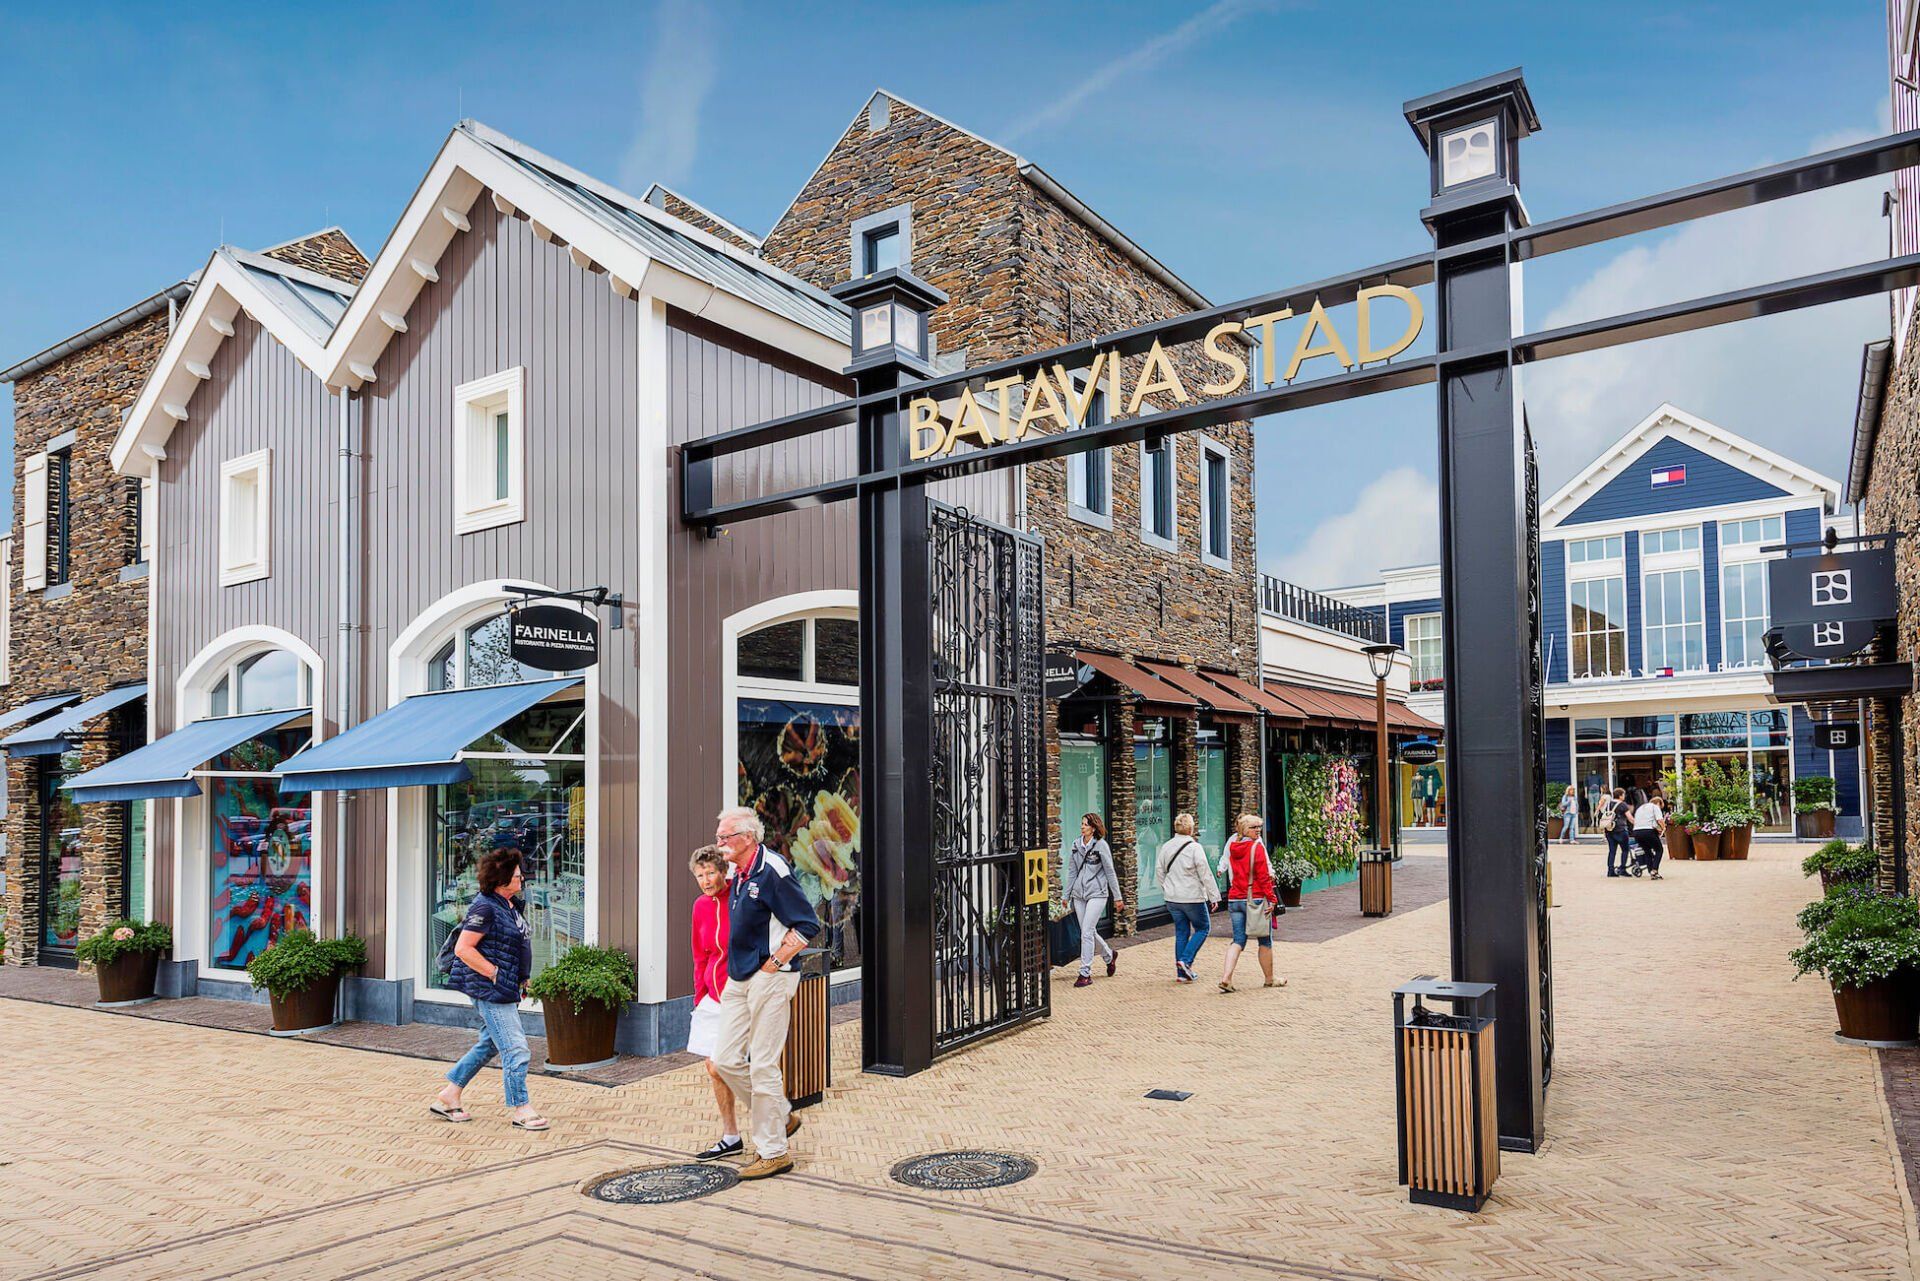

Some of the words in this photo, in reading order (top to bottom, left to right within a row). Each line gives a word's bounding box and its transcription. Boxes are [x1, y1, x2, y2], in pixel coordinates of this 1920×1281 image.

[910, 339, 1190, 460] BATAVIA
[1202, 284, 1425, 396] STAD
[515, 624, 595, 644] FARINELLA
[515, 639, 546, 647] RISTORANTE
[565, 643, 595, 652] NAPOLETANA
